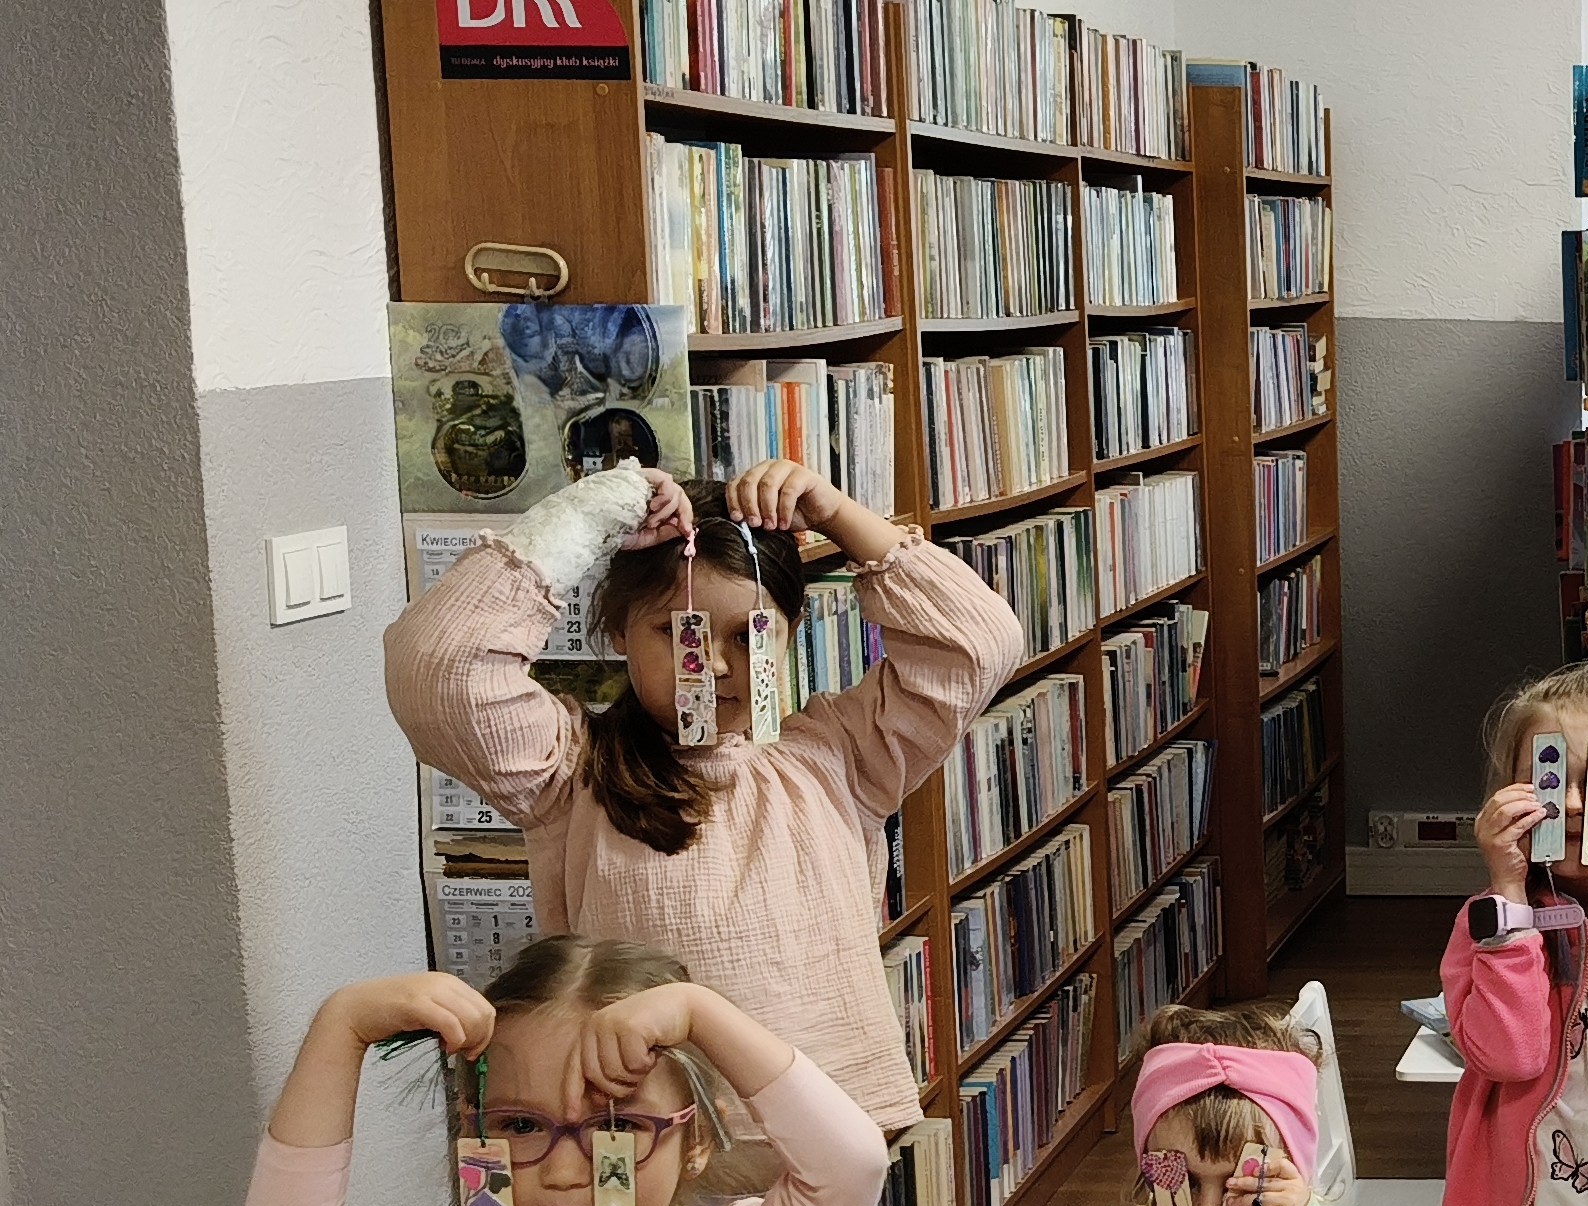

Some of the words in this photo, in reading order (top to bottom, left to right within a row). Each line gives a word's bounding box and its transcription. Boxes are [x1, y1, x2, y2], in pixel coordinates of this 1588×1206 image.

[493, 55, 554, 68] dyskusyjny
[556, 55, 579, 66] klub
[582, 56, 619, 68] książki
[421, 534, 477, 547] KWIECIEŃ
[568, 604, 581, 616] 16
[567, 621, 581, 634] 23
[567, 639, 582, 651] 30
[478, 811, 493, 824] 25
[442, 885, 502, 897] CZERWIEC
[508, 886, 533, 897] 202
[492, 915, 499, 927] 1
[525, 916, 533, 927] 2
[493, 933, 500, 944] 8
